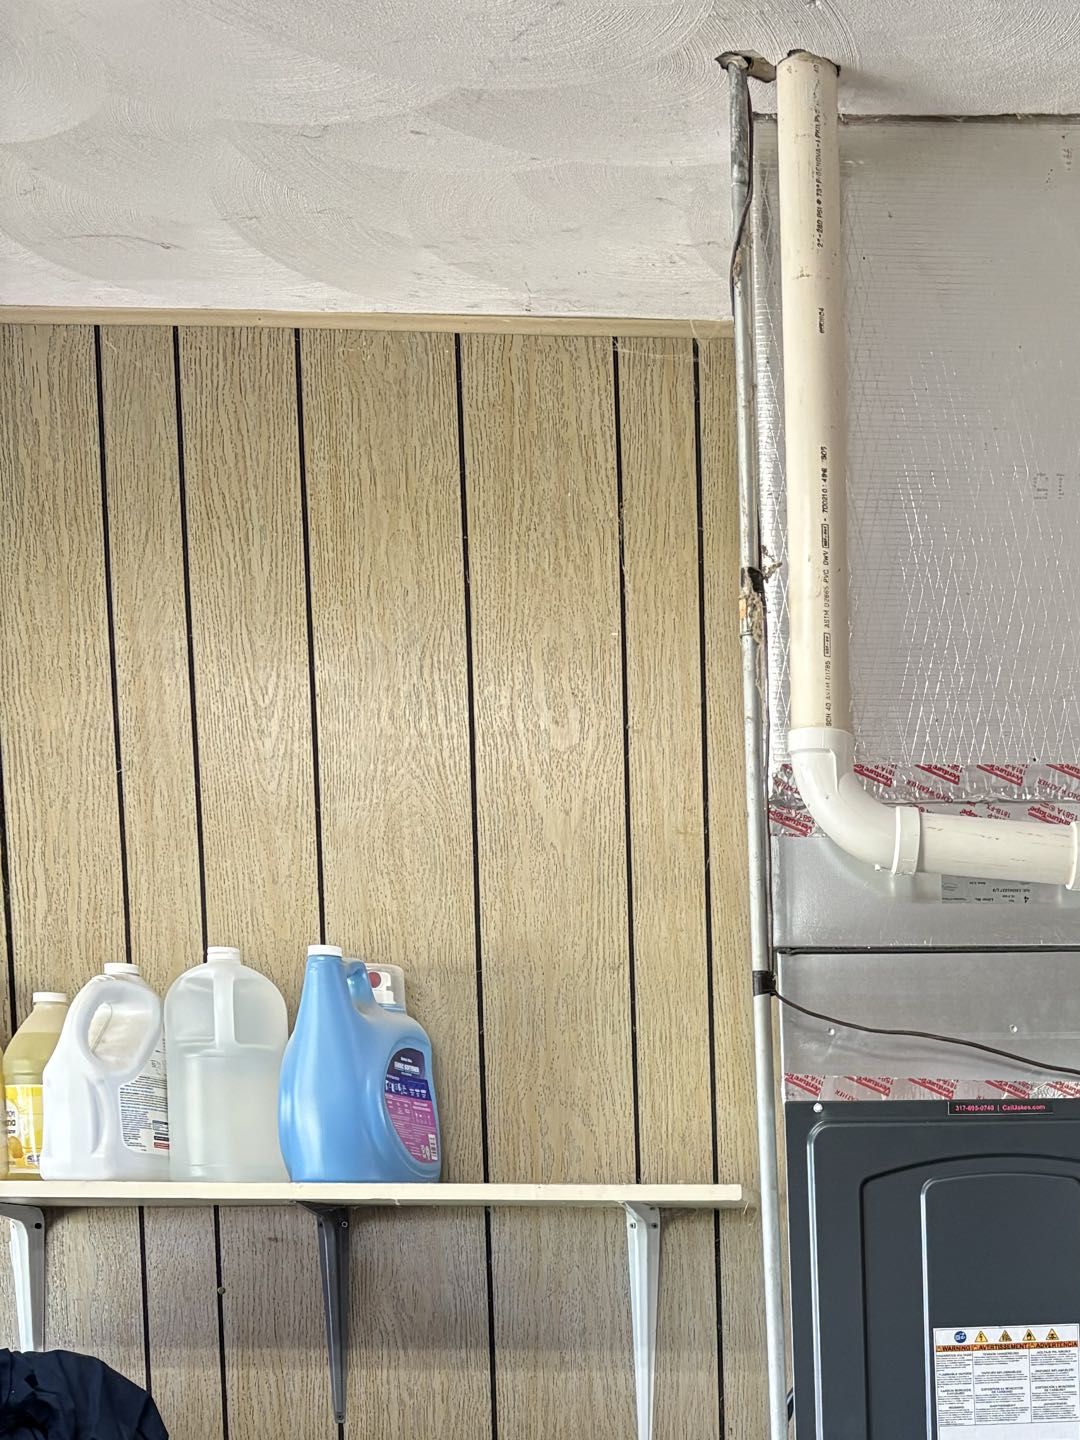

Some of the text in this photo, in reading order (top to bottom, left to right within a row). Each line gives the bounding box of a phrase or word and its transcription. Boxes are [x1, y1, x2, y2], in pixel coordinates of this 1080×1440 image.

[769, 810, 812, 833] VentureTap
[1028, 806, 1071, 826] entureTape
[942, 1341, 1078, 1352] WARNING AVERTISSEMENT ADVERTENCIA
